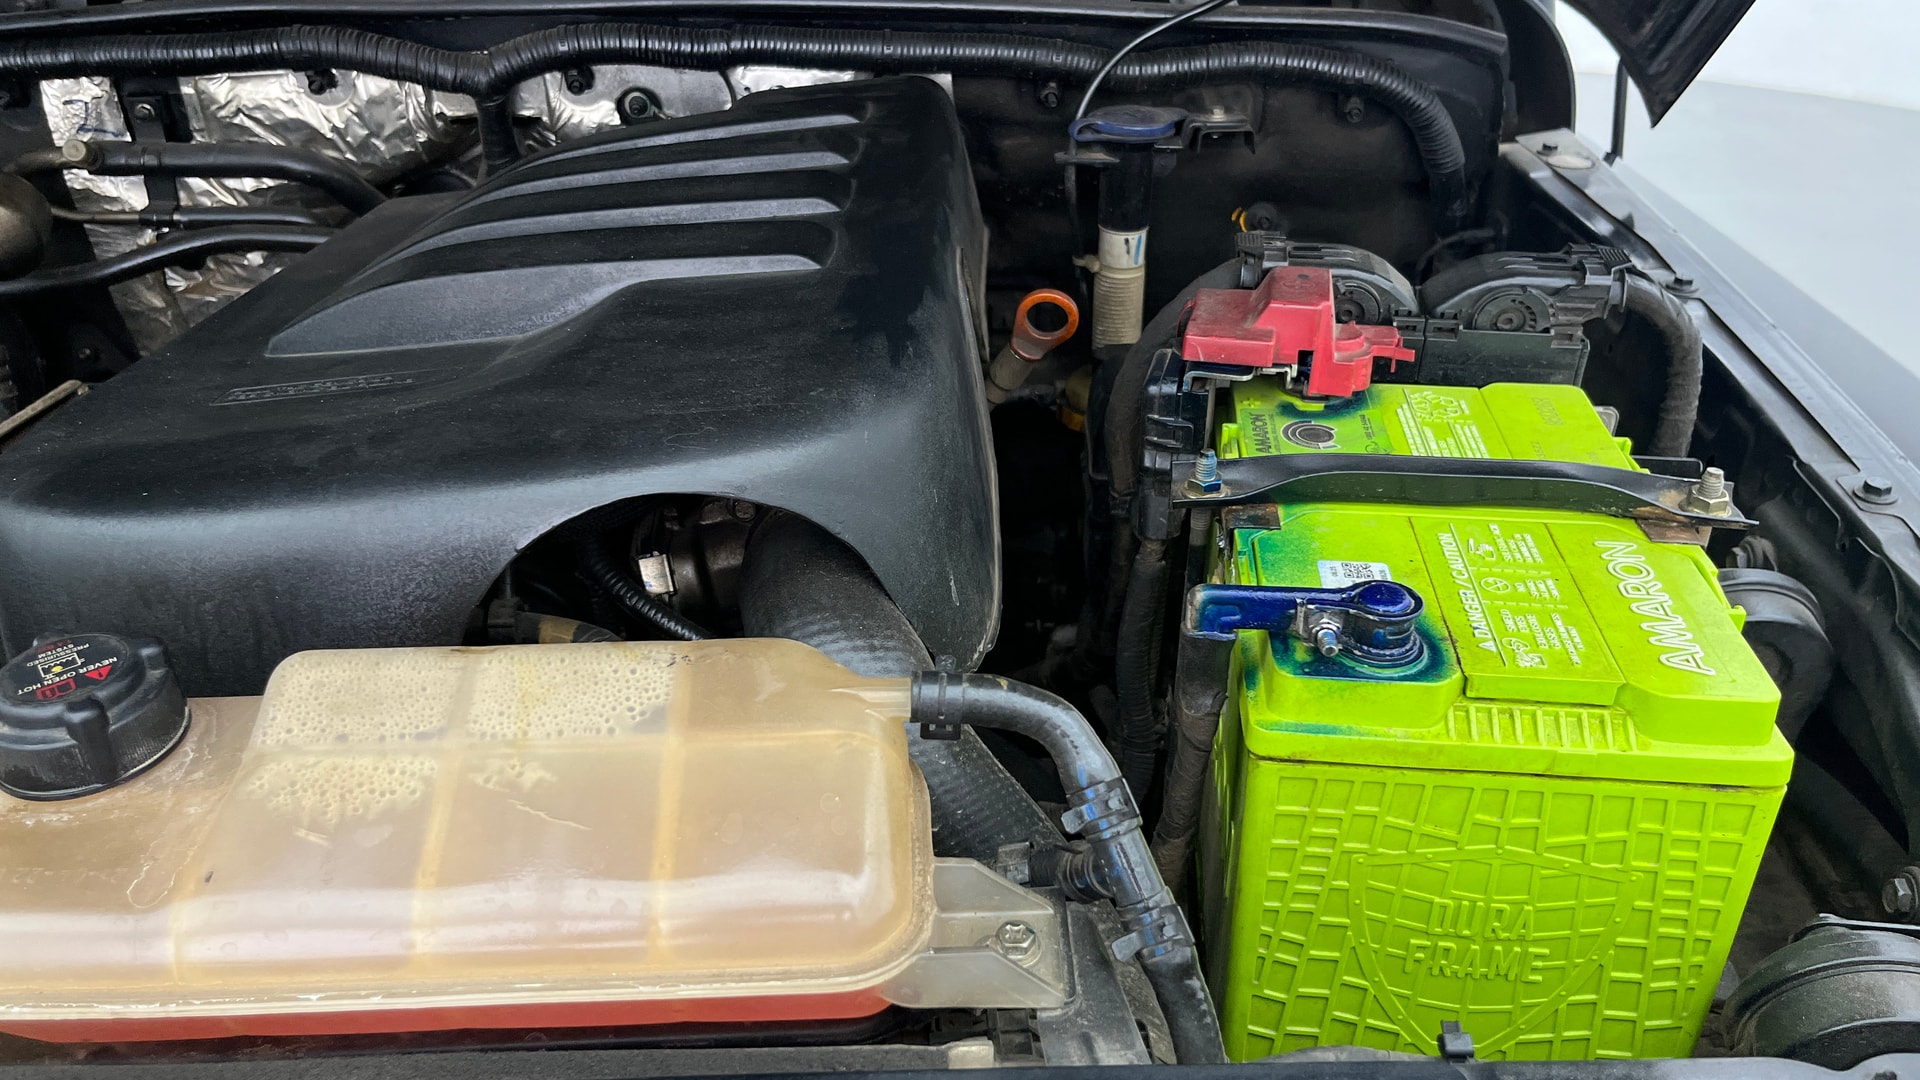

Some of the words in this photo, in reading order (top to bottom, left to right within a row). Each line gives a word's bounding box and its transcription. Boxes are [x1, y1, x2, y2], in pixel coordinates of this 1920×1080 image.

[1250, 413, 1272, 455] AMARON
[1437, 532, 1469, 579] CAUTION
[1459, 589, 1492, 639] DANGER
[1594, 541, 1716, 676] AMARON
[1515, 615, 1529, 633] EYES
[1544, 627, 1562, 649] GASES
[26, 643, 90, 667] PRESSURISED
[37, 643, 75, 659] SYSTEM
[78, 656, 118, 674] NEVER
[16, 682, 42, 696] HOT
[43, 671, 77, 686] OPEN
[1428, 899, 1534, 940] DURA
[1404, 939, 1550, 983] FRAME
